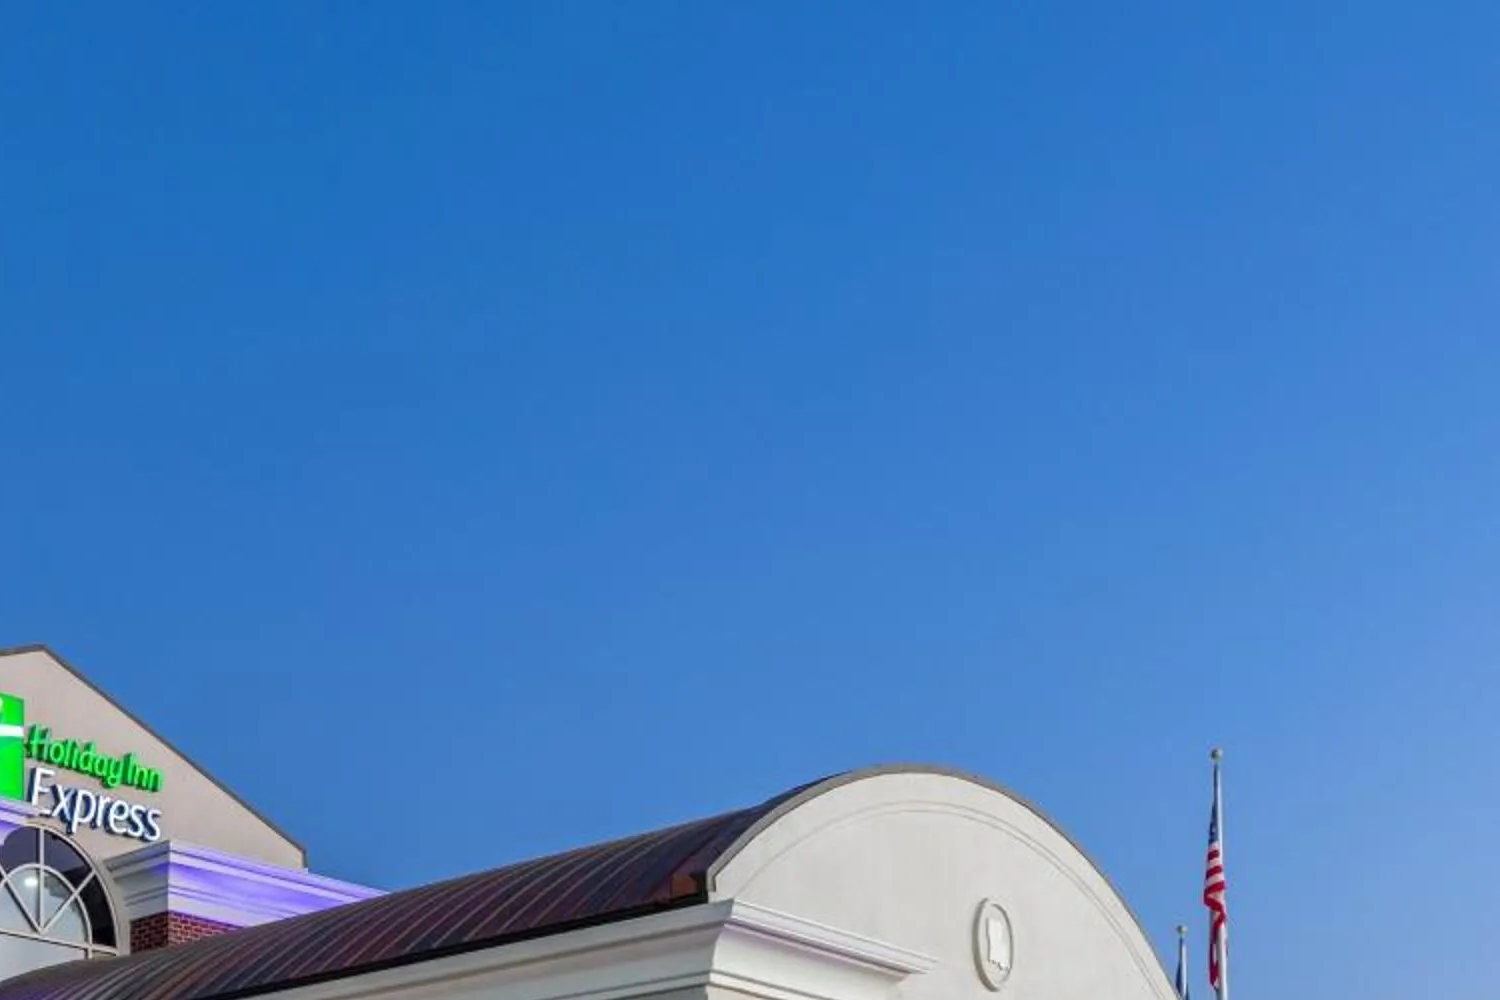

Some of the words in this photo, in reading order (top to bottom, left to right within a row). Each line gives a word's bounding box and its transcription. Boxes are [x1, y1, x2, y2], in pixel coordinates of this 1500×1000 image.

[27, 724, 120, 787] Holiday
[124, 752, 162, 791] Inn
[29, 766, 162, 841] Express
